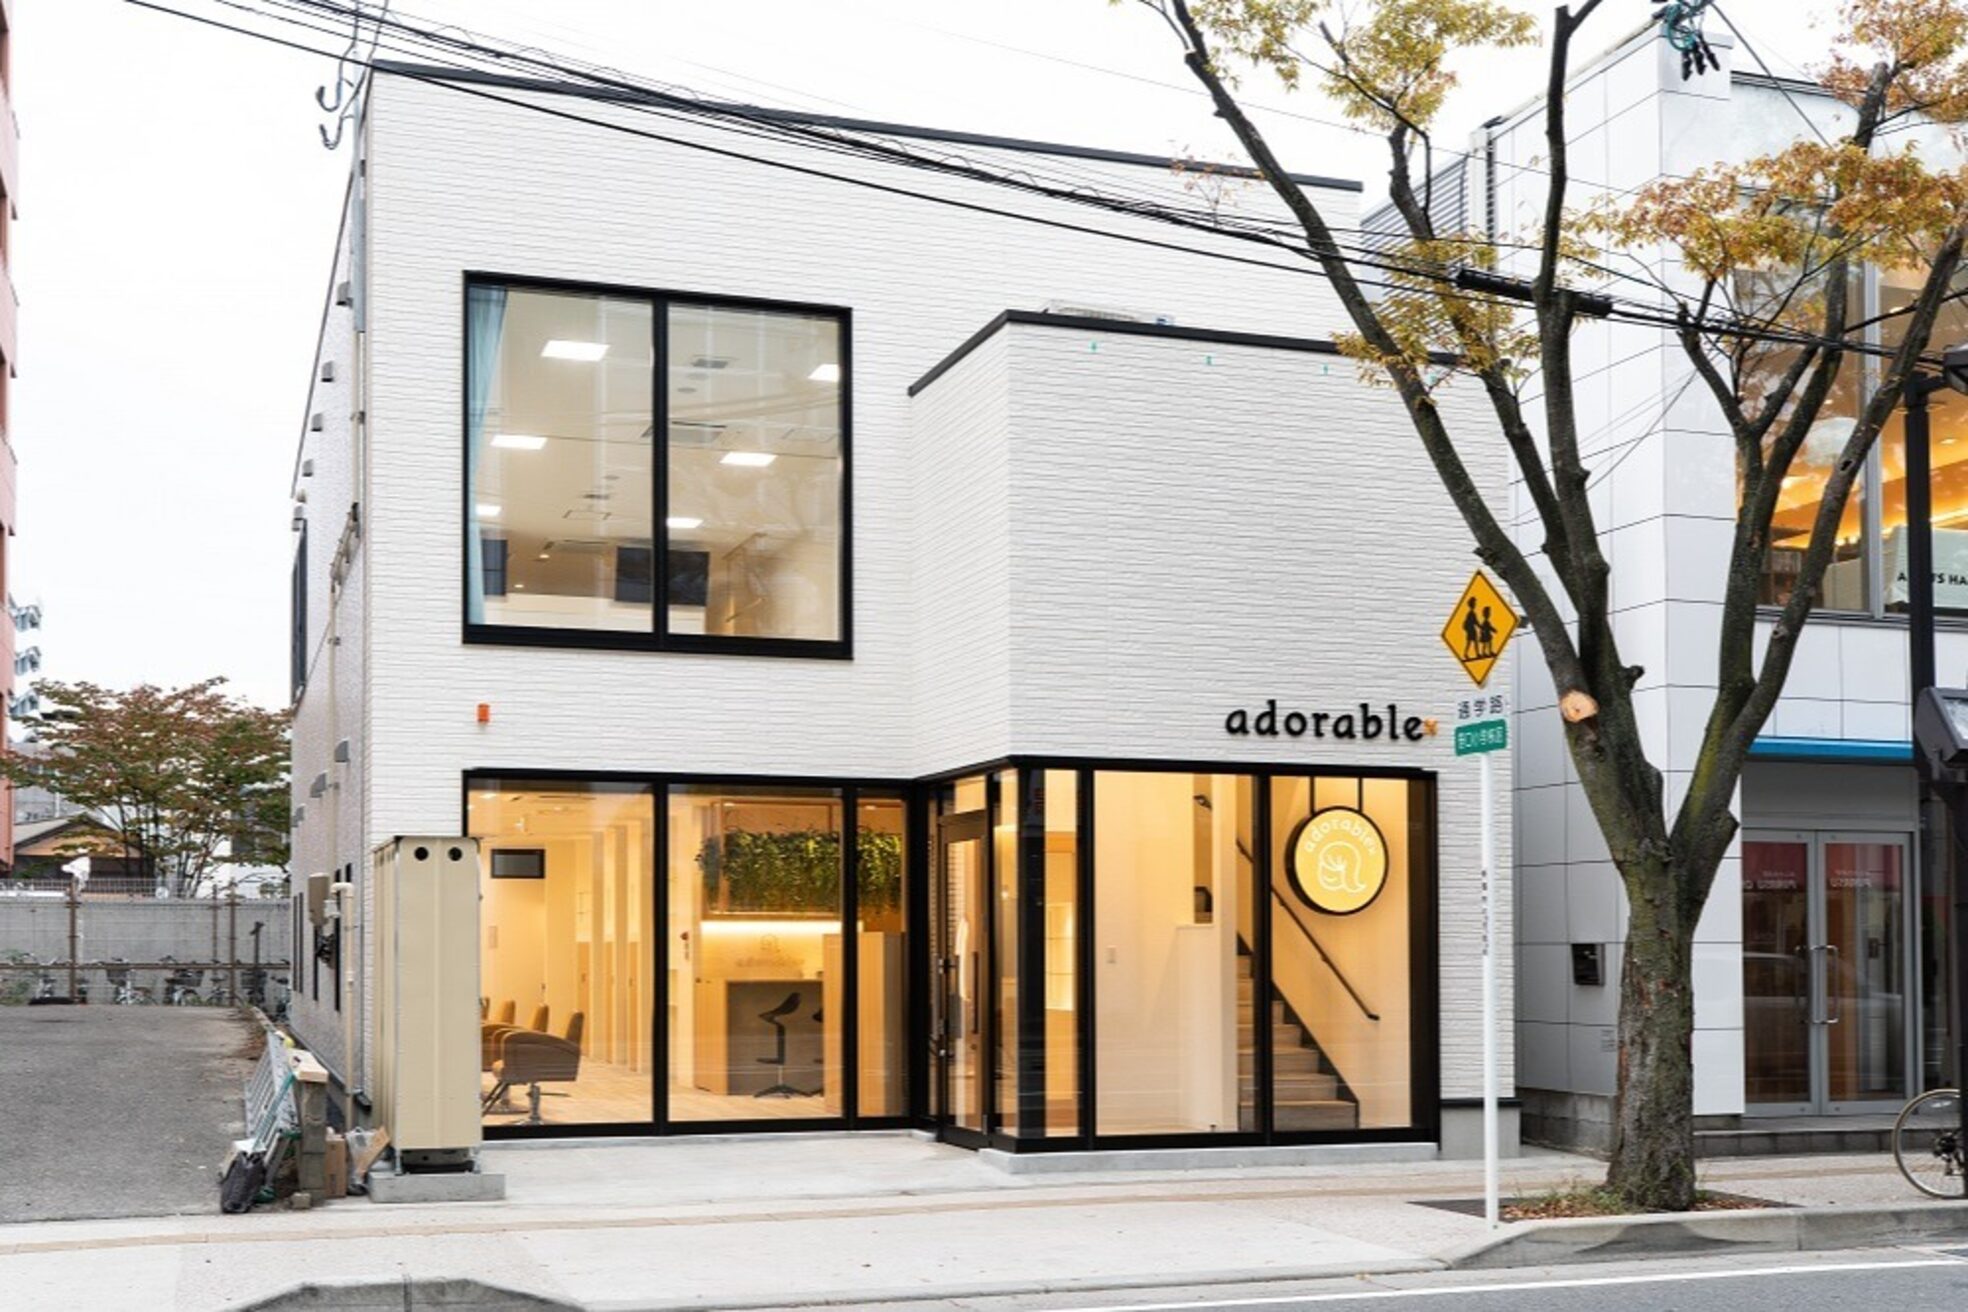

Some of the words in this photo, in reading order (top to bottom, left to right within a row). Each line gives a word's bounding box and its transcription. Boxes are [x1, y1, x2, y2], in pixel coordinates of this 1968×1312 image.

[1225, 699, 1424, 741] adorable
[1457, 695, 1502, 719] 通学路
[1304, 818, 1375, 853] adorable
